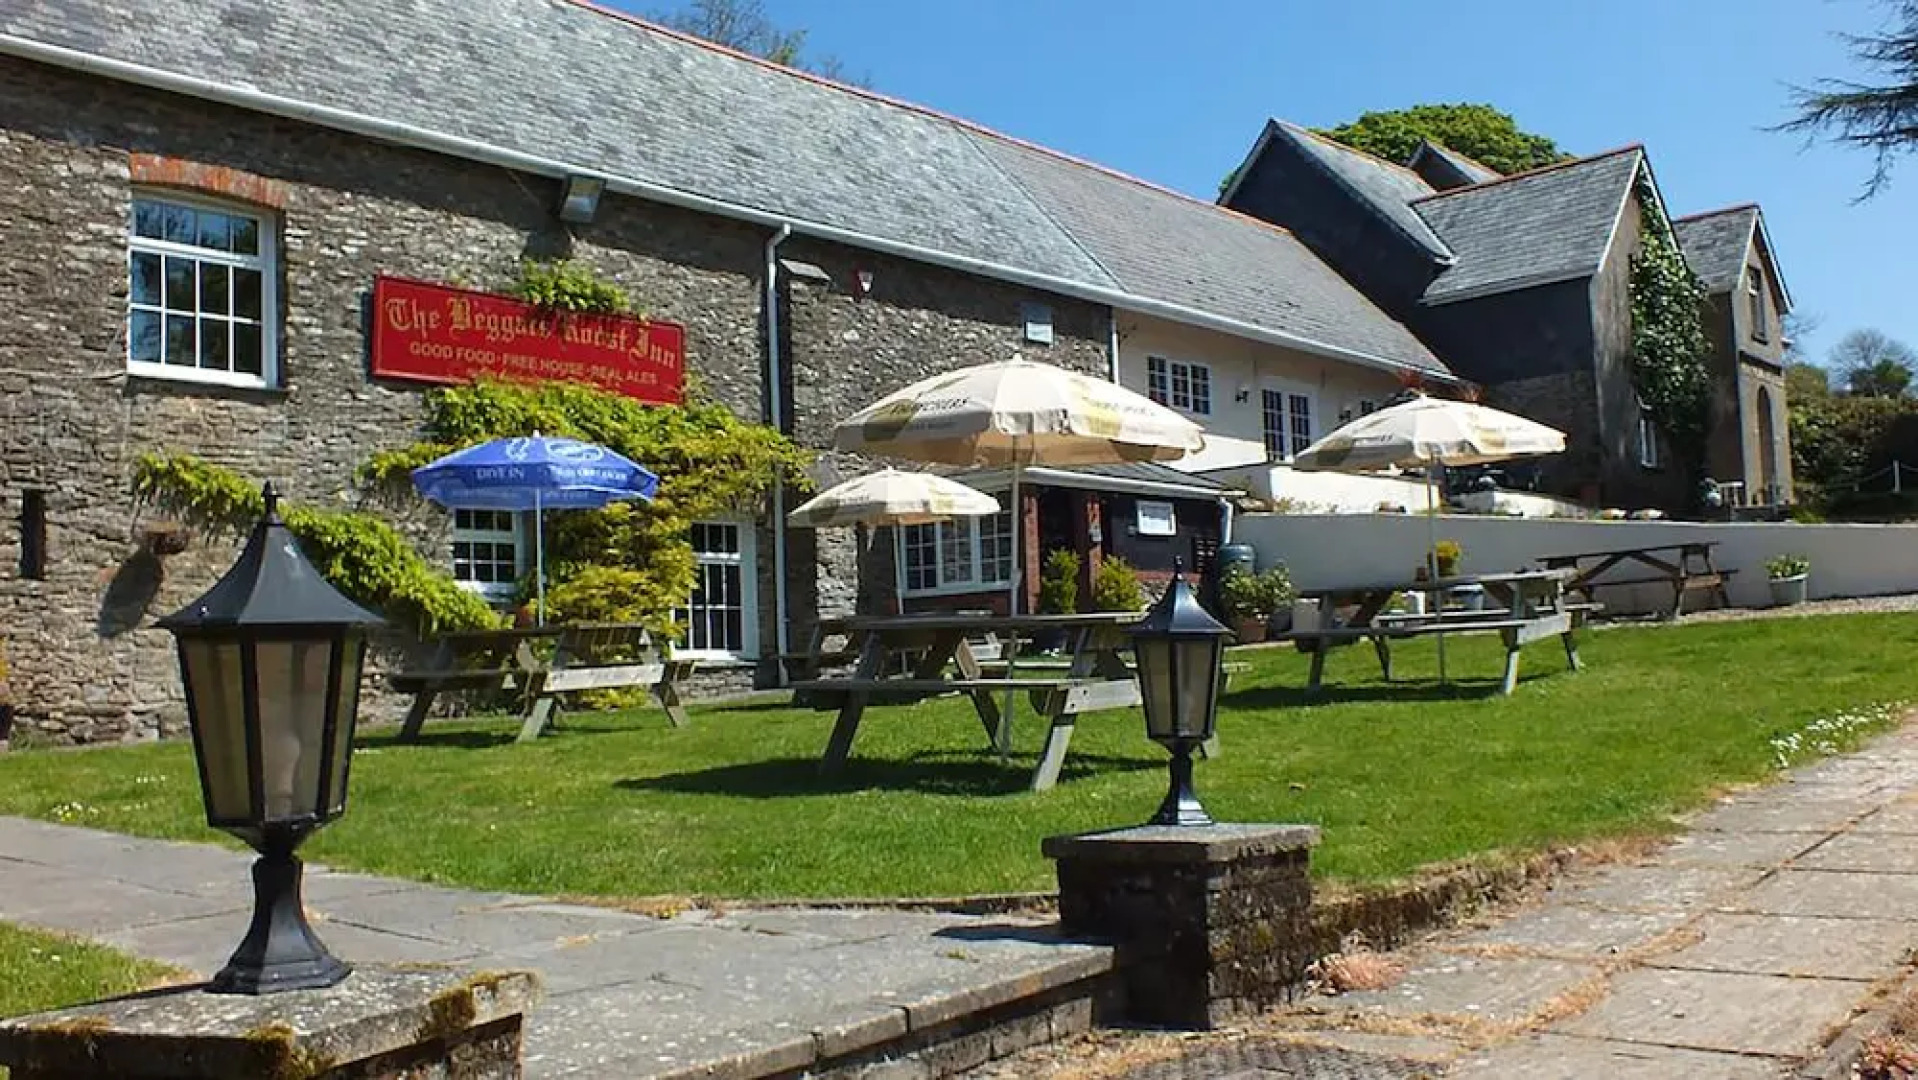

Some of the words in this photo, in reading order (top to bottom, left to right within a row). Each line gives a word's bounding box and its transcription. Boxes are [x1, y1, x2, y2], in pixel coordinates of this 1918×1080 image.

[385, 298, 440, 339] The
[629, 328, 676, 369] Inn
[410, 341, 453, 359] GOOD
